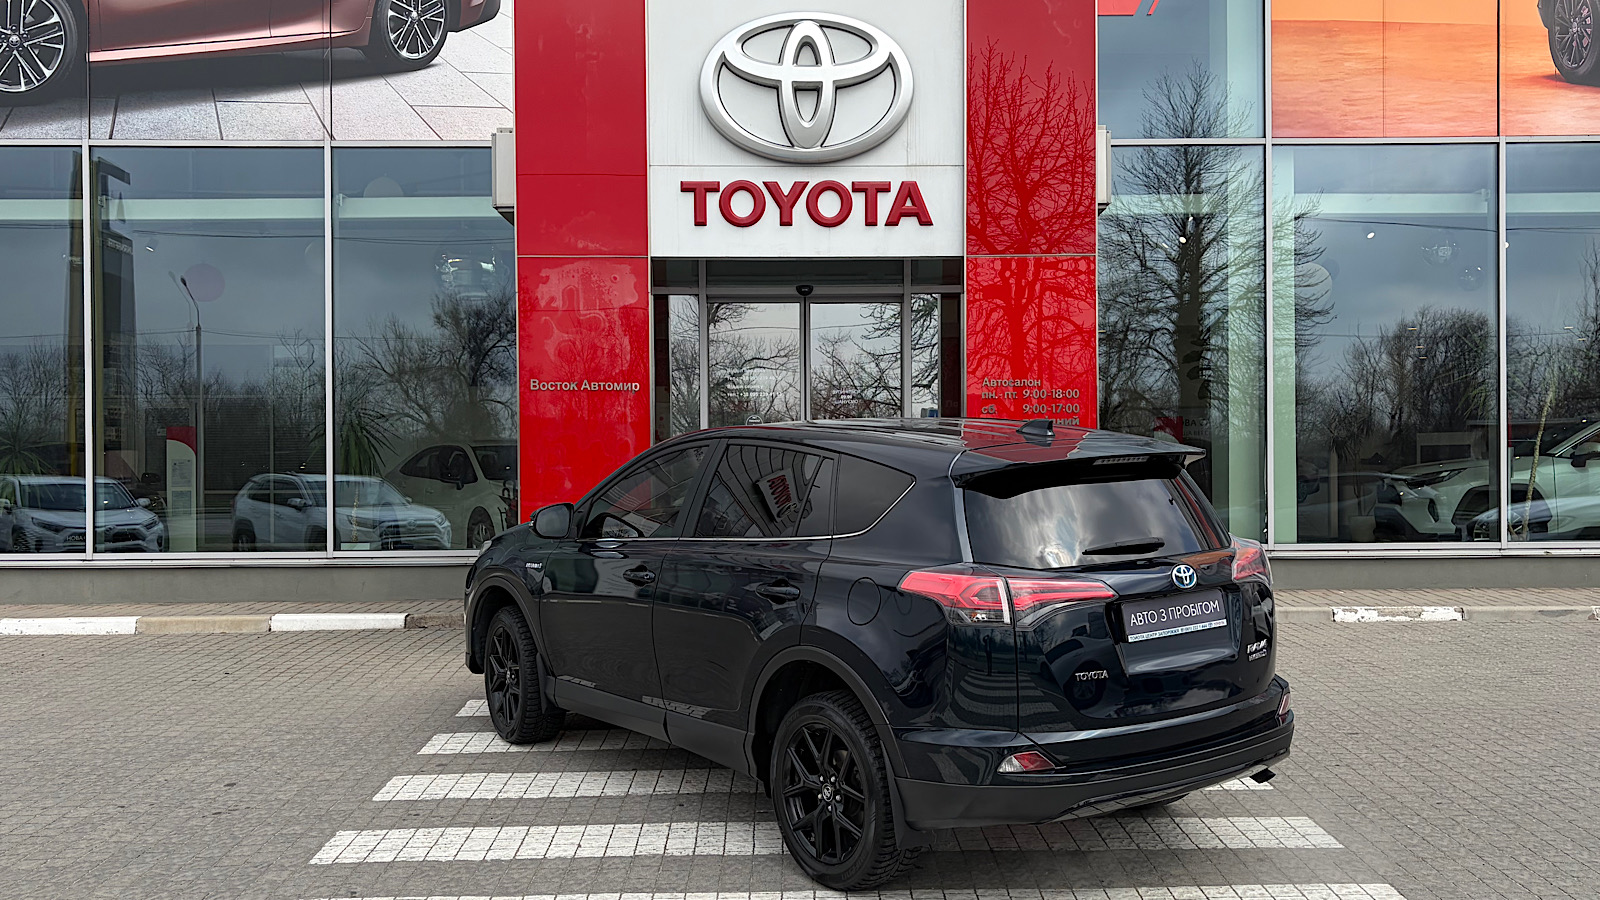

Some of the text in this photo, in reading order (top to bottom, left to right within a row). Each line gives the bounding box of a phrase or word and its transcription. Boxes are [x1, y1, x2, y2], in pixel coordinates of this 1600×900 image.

[680, 180, 934, 227] TOYOTA
[530, 378, 640, 394] Восток Автомир
[982, 377, 1041, 387] Автосалон
[1022, 388, 1080, 399] 9:00-18:00
[1022, 403, 1080, 414] 9:00-17:00
[1130, 600, 1220, 627] АВТО З ПРОБІГОМ
[1074, 669, 1109, 682] TOYOTA
